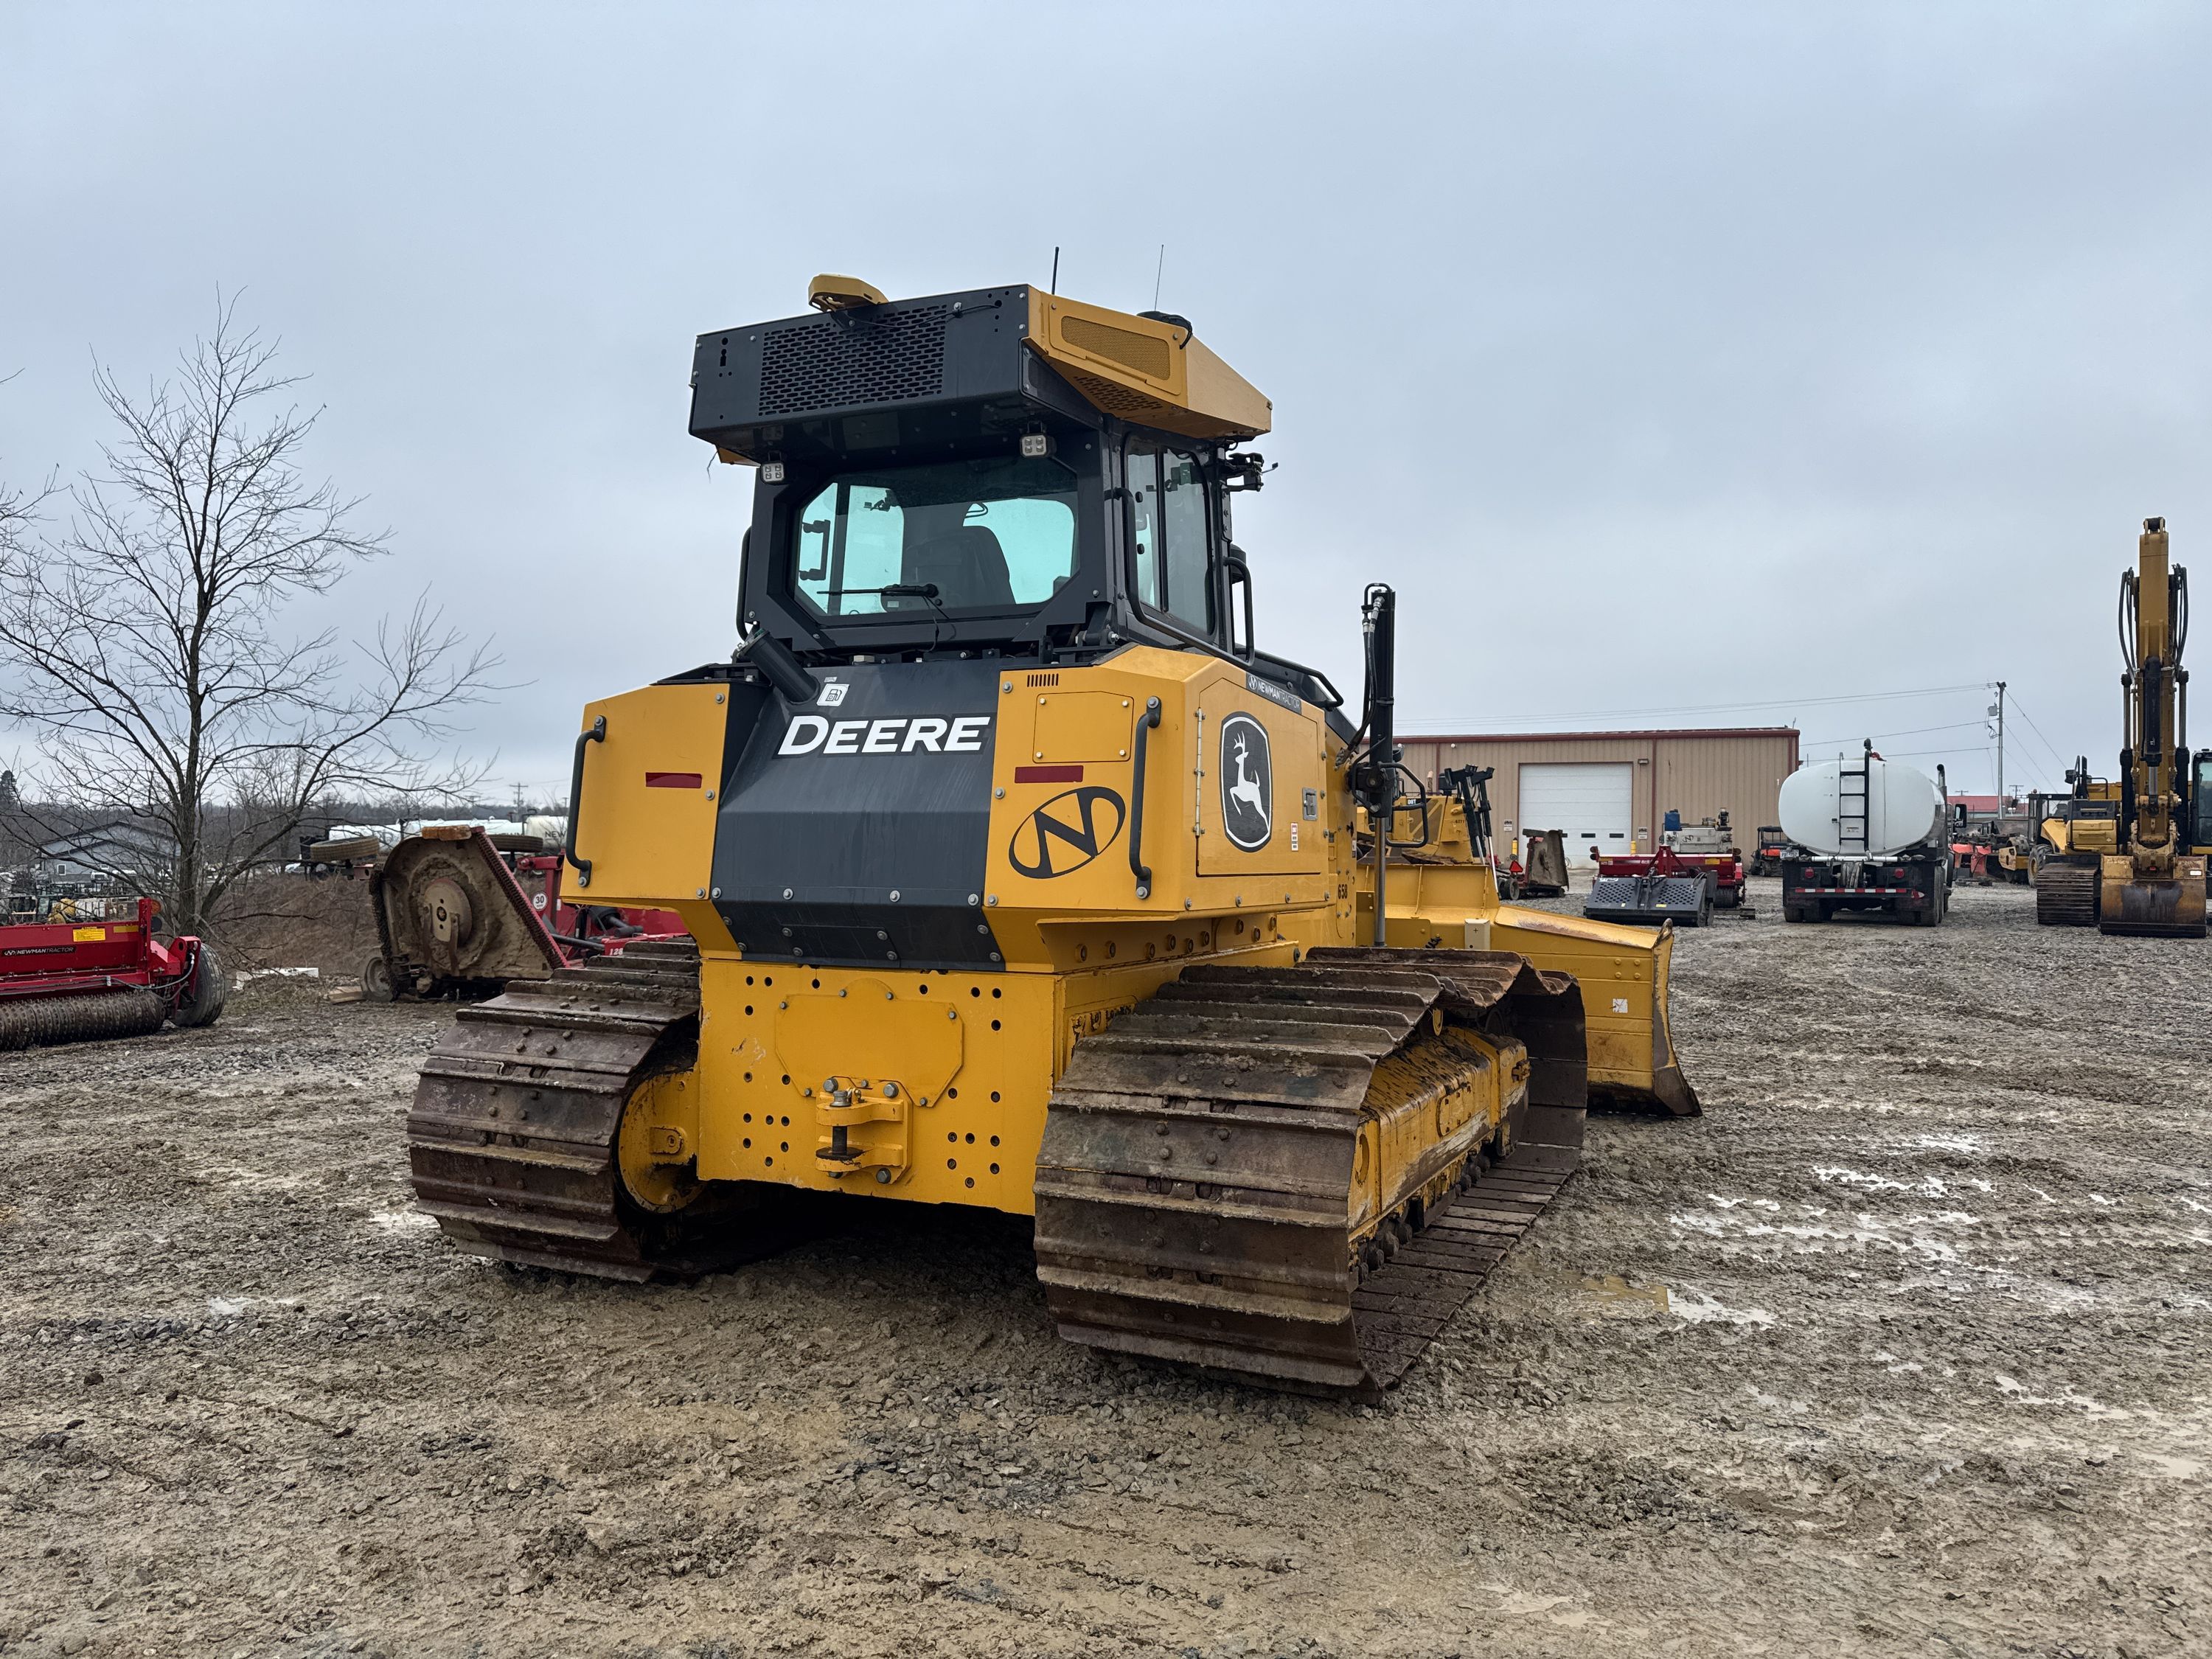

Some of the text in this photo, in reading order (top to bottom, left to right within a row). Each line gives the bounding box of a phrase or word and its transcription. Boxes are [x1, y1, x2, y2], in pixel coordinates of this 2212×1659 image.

[777, 715, 991, 756] DEERE
[1338, 884, 1348, 899] 658
[535, 896, 545, 904] 30
[16, 947, 74, 955] NEWMANTRACTOR
